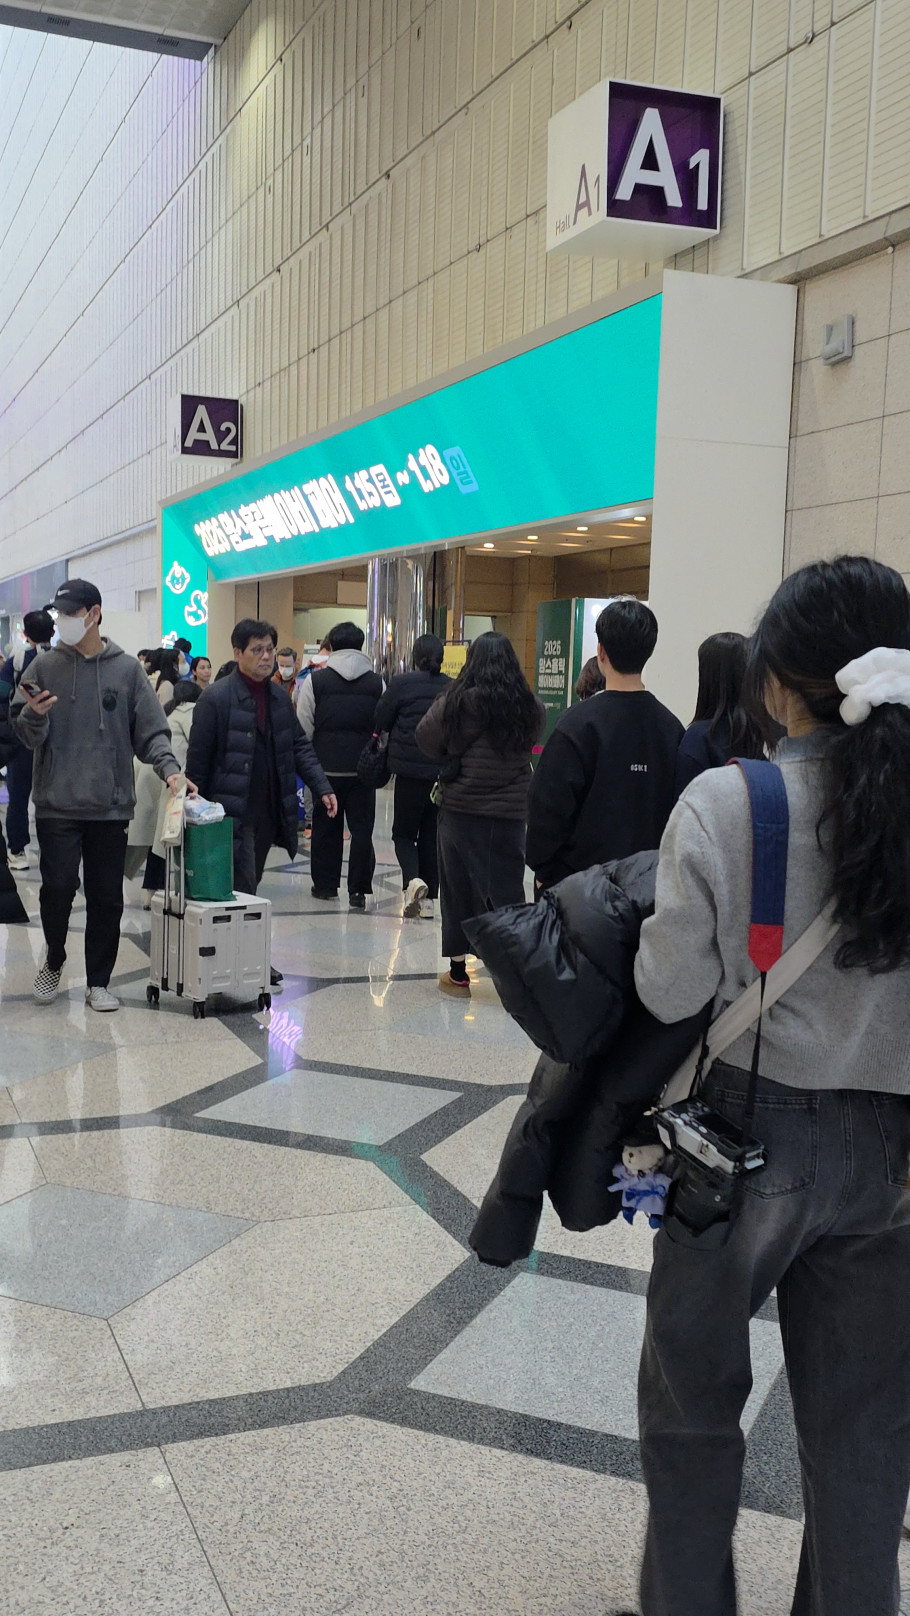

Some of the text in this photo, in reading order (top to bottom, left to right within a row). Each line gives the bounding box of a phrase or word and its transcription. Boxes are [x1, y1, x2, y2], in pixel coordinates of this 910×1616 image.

[614, 107, 710, 211] A1
[555, 163, 601, 236] Hall A1
[184, 404, 237, 452] A2
[407, 444, 450, 493] 1.18
[544, 641, 561, 655] 2026
